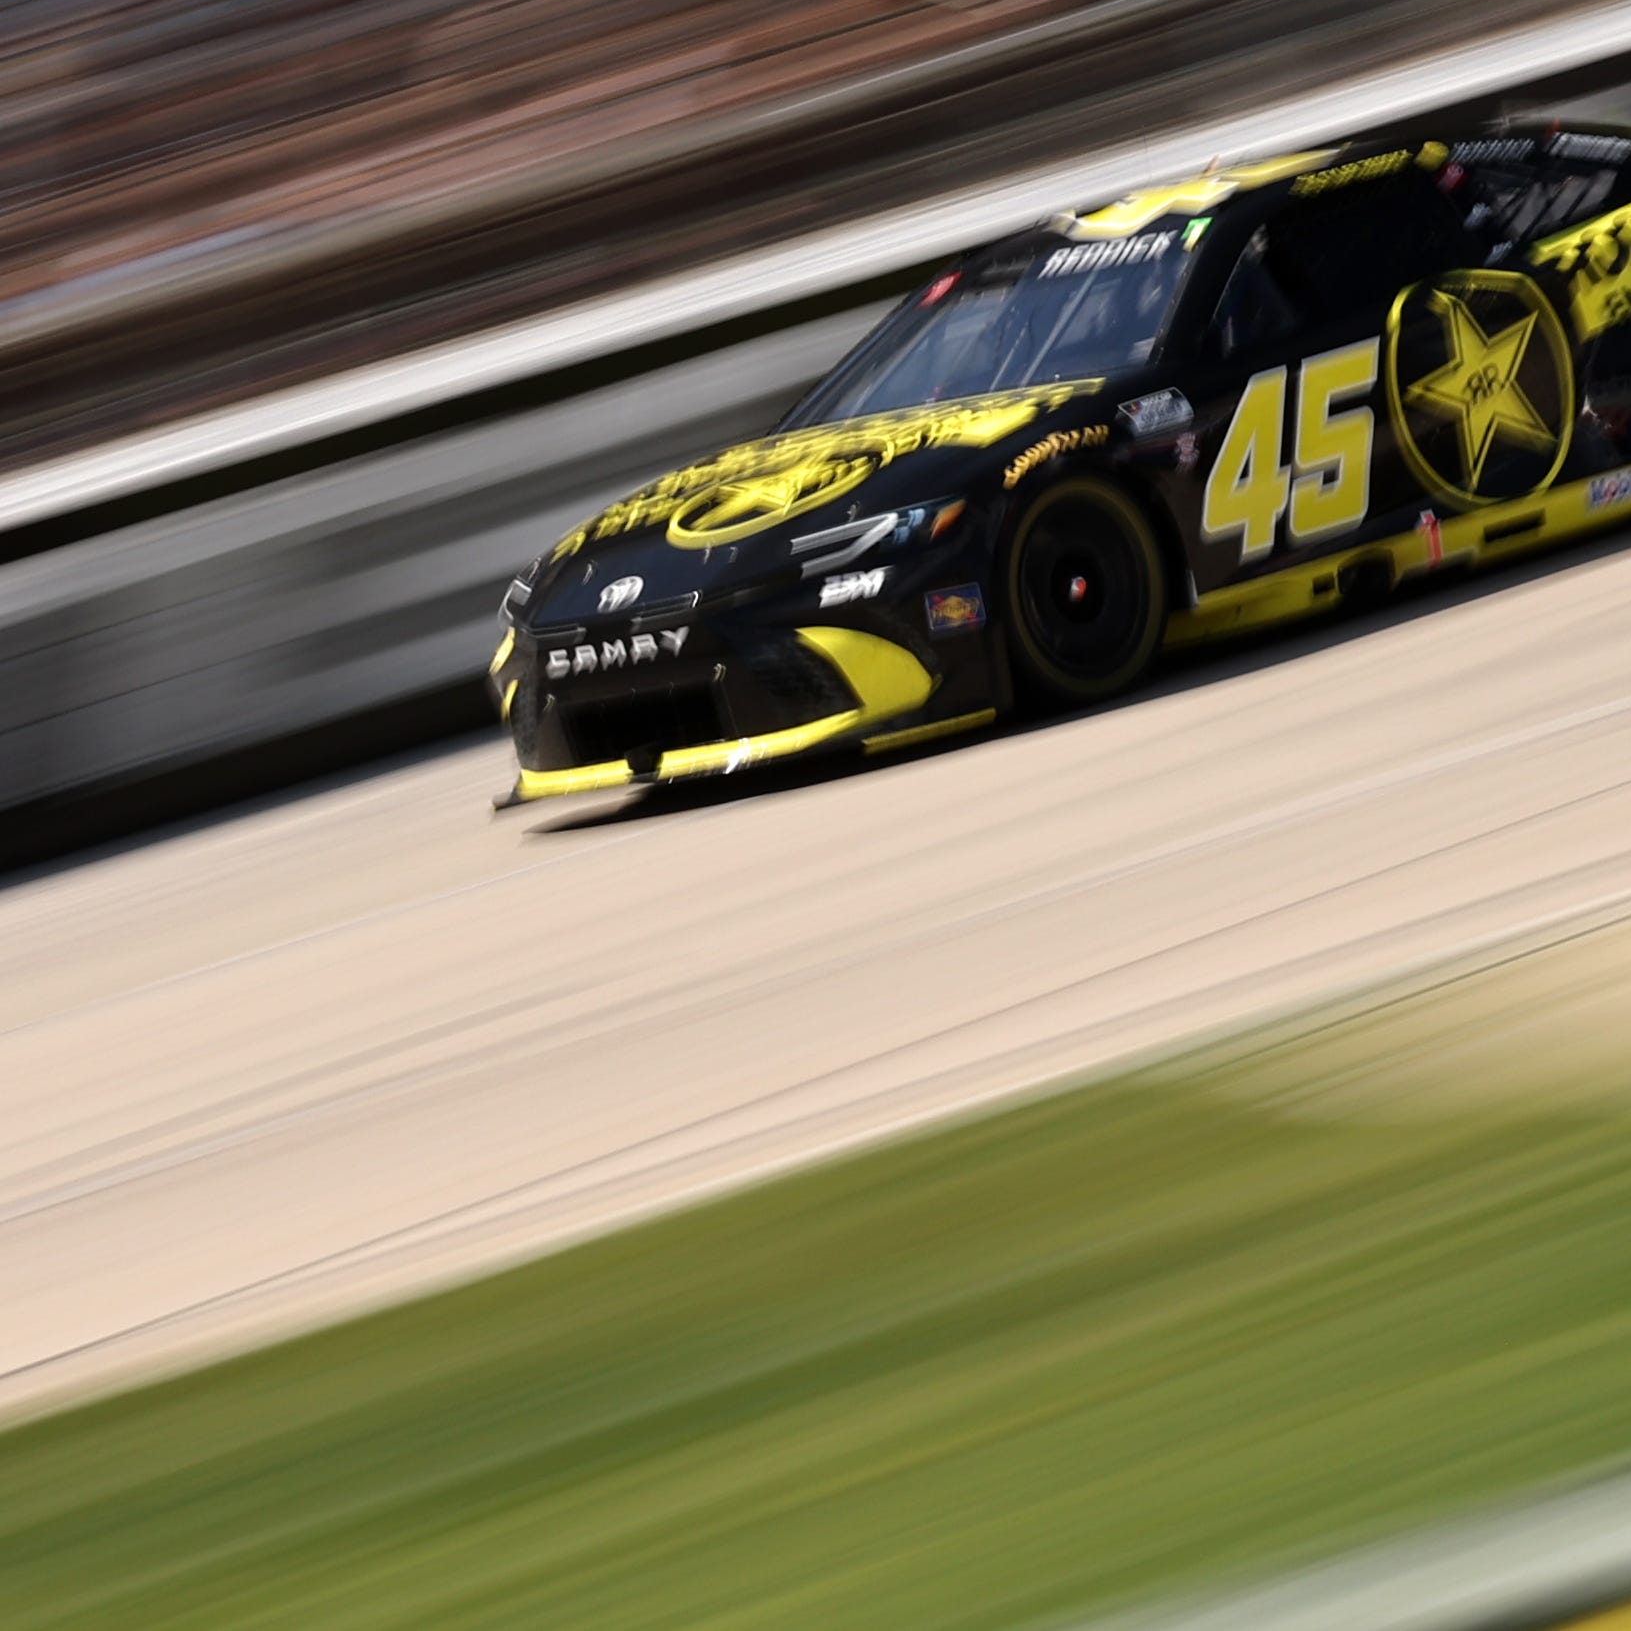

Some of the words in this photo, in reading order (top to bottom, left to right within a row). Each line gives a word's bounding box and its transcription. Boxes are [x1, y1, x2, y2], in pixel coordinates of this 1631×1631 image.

[1003, 424, 1110, 491] GOODYEAR
[1201, 334, 1380, 566] 45
[545, 626, 690, 680] CAMRY
